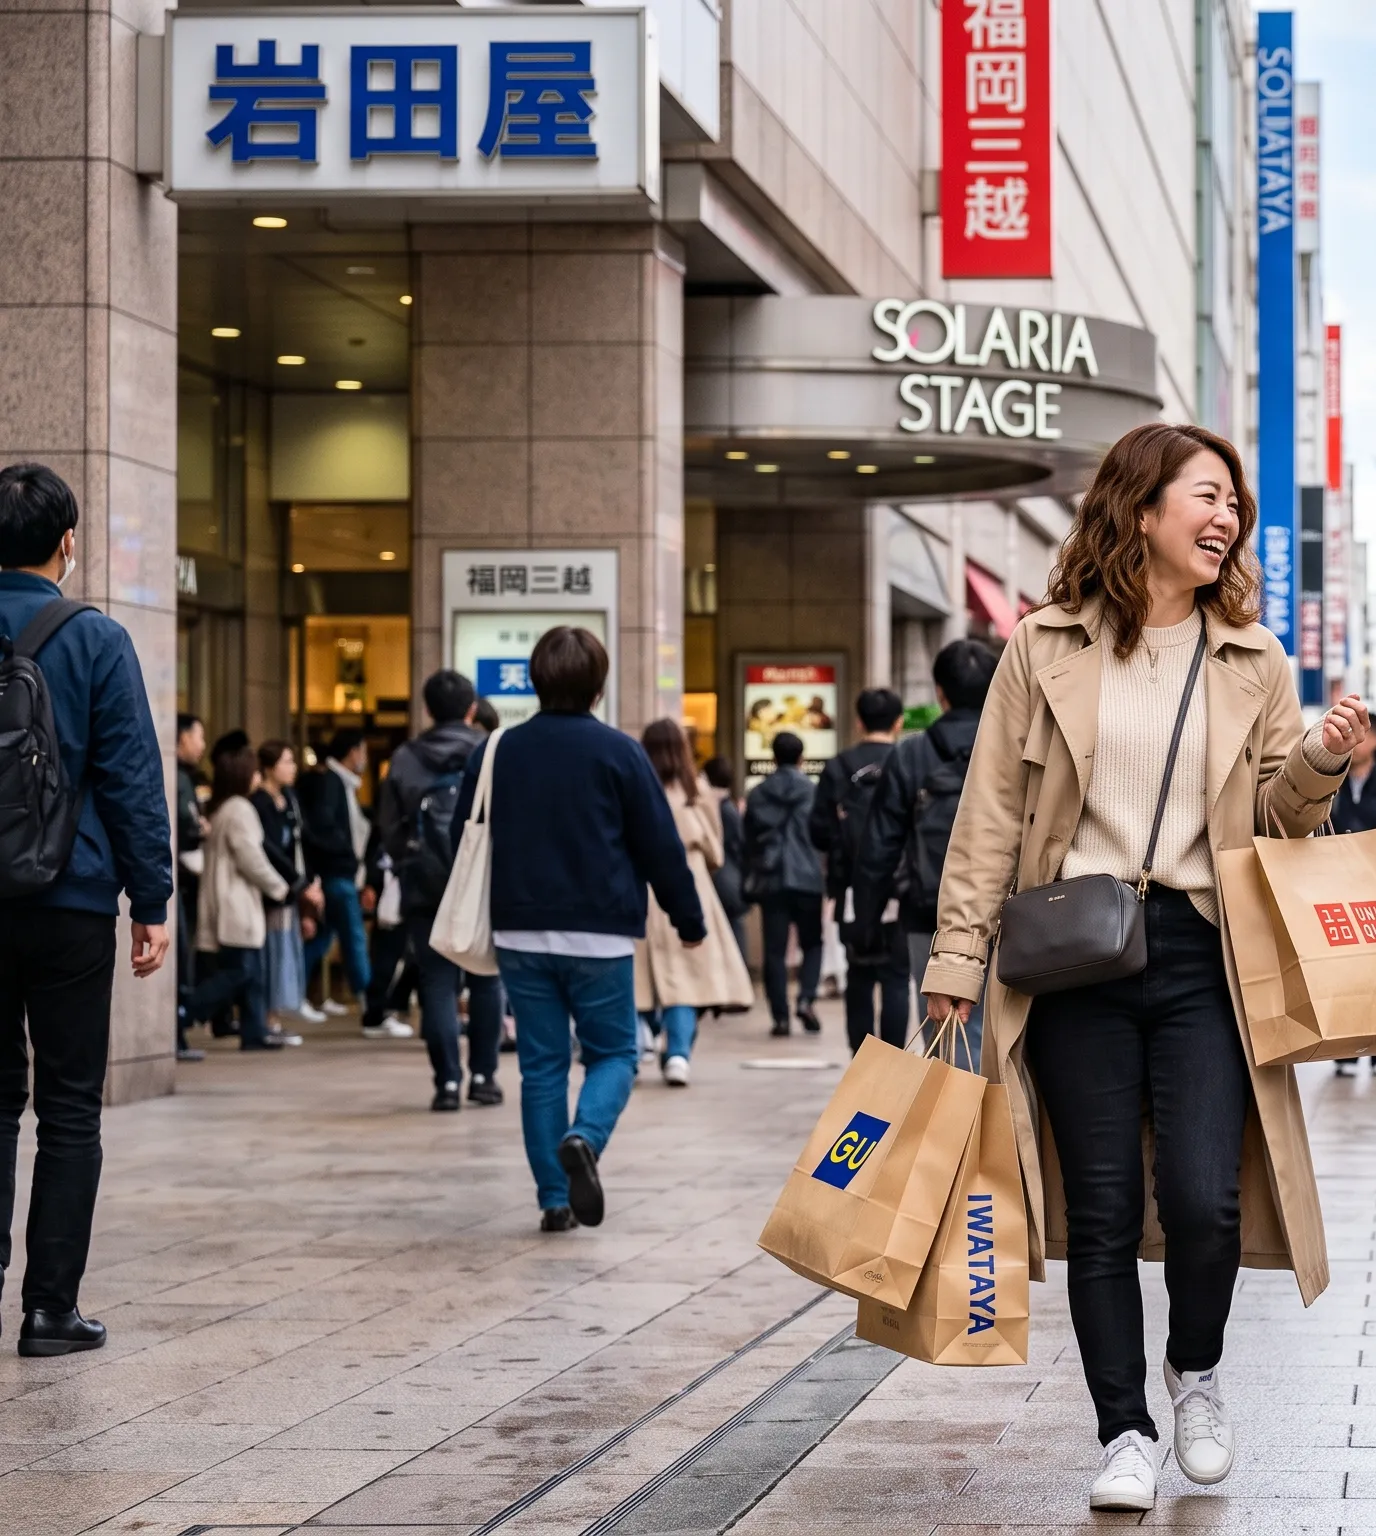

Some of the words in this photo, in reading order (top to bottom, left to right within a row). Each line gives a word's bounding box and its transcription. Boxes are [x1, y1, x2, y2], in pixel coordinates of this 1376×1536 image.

[206, 39, 597, 163] 岩田屋
[963, 0, 1029, 241] 福岡三越
[872, 297, 1100, 377] SOLARIA
[900, 373, 1063, 439] STAGE
[467, 564, 592, 596] 福岡三越
[829, 1130, 877, 1171] GU
[967, 1194, 996, 1336] IWATAYA
